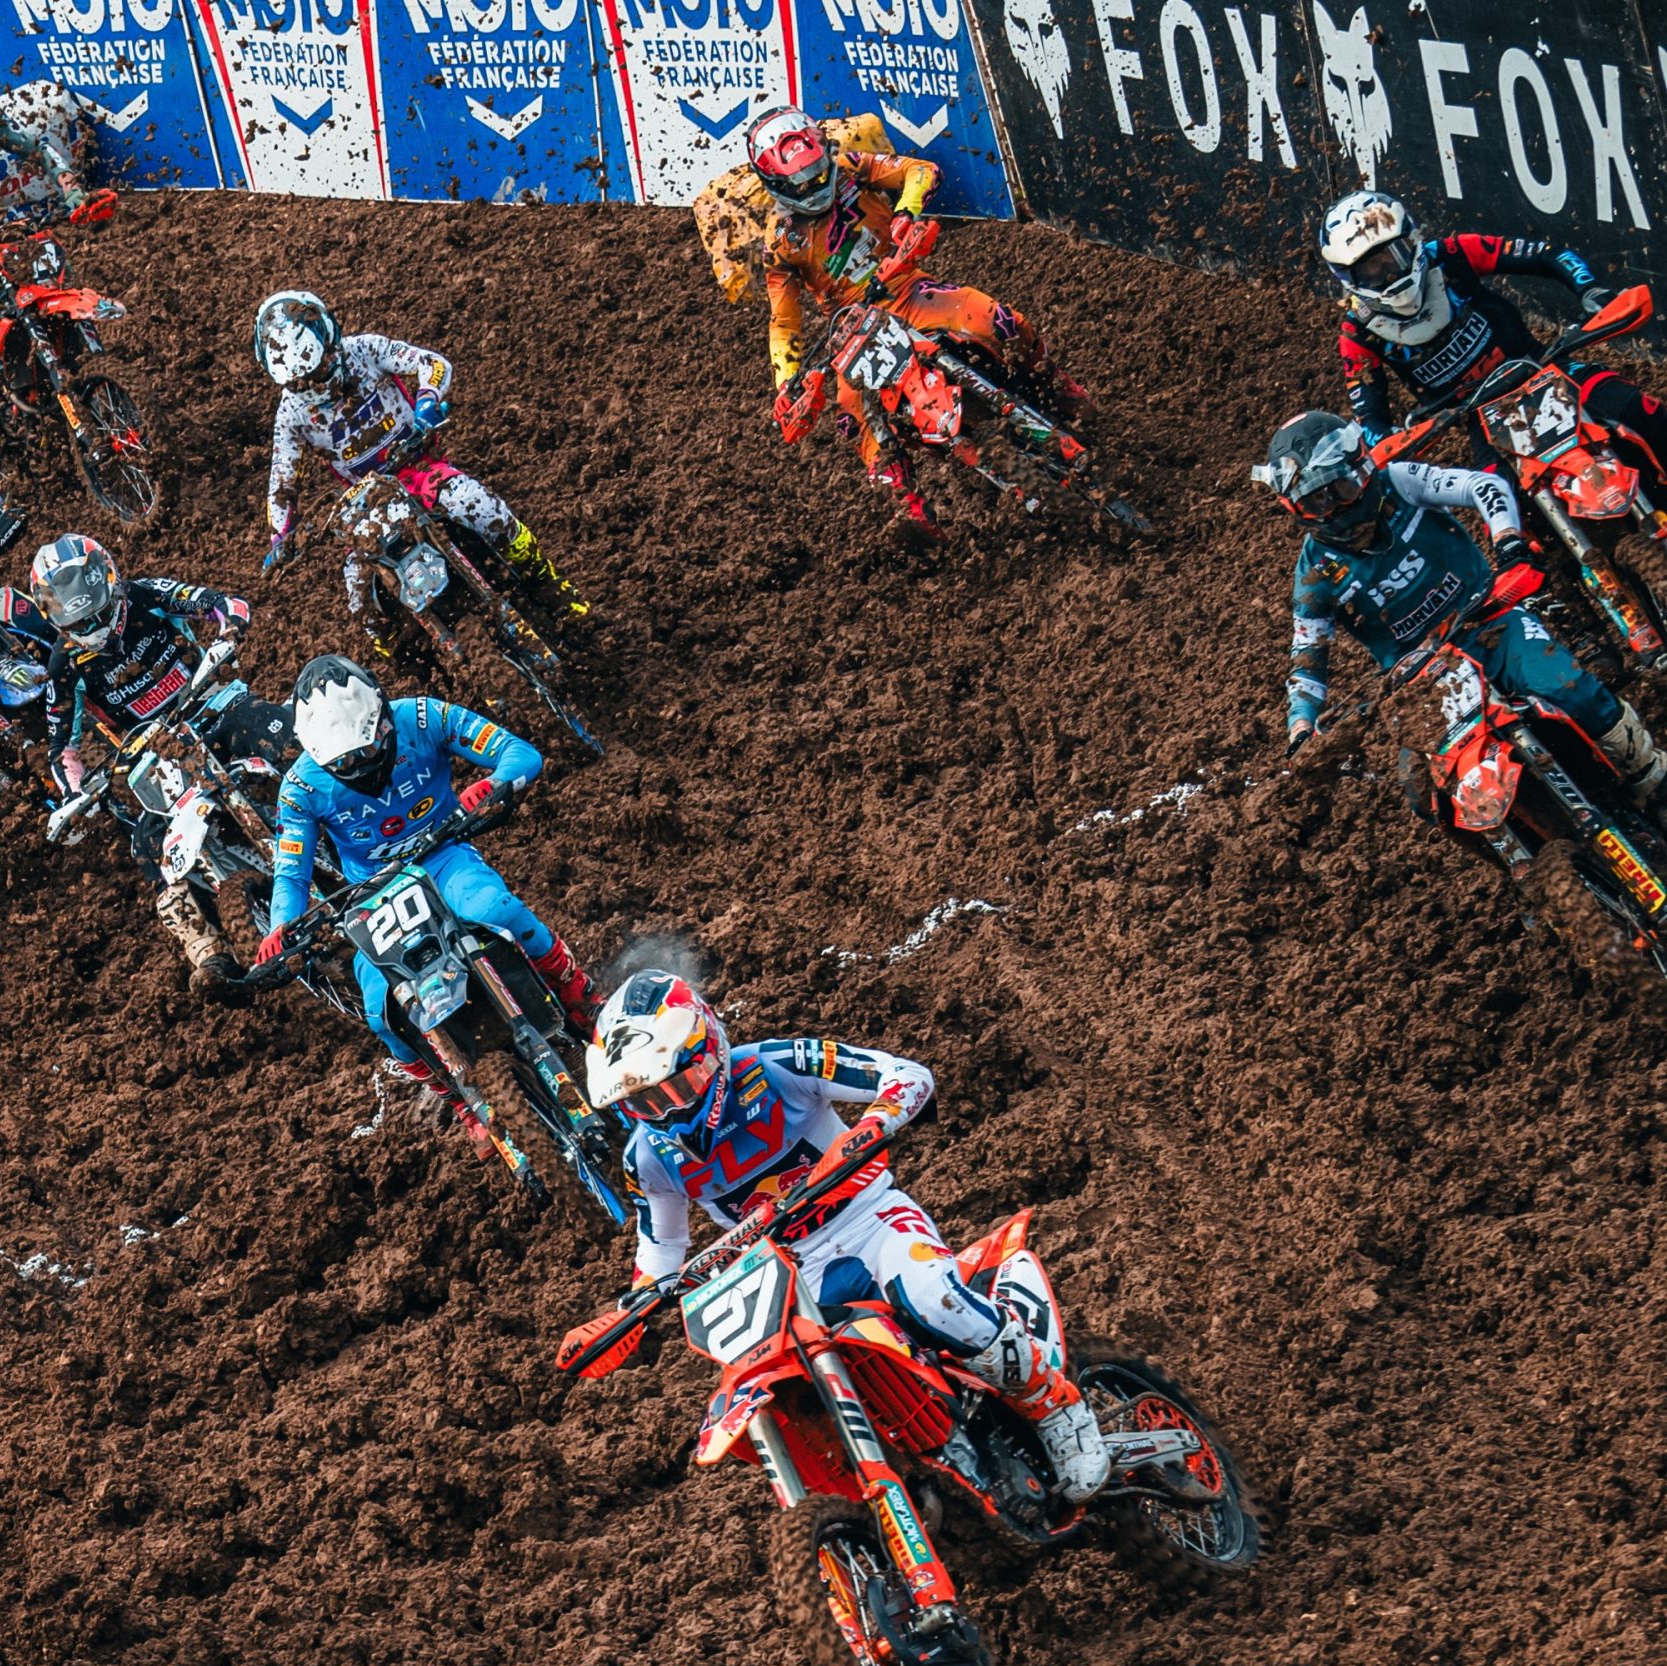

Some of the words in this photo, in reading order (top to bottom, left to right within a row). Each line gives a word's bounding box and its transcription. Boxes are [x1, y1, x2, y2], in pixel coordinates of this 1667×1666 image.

[37, 36, 165, 65] FÉDÉRATION
[241, 36, 348, 66] FÉDÉRATION
[428, 35, 566, 66] FÉDÉRATION
[644, 34, 767, 64] FÉDÉRATION
[844, 36, 959, 71] FÉDÉRATION
[51, 63, 163, 88] FRANÇAISE
[250, 66, 346, 89] FRANÇAISE
[440, 66, 561, 93] FRANÇAISE
[658, 63, 765, 90] FRANÇAISE
[856, 68, 959, 98] FRANÇAISE
[1094, 0, 1296, 168] FOX
[1418, 39, 1650, 230] FOX
[1415, 313, 1487, 383] HORVÁTH
[336, 767, 431, 824] RAVEN
[1600, 834, 1663, 911] PIRELLI
[367, 884, 431, 956] 20
[598, 1074, 651, 1104] AIROH
[717, 1121, 739, 1139] DEKRA
[842, 1130, 873, 1158] KTM
[680, 1100, 785, 1200] FLY
[702, 1259, 778, 1365] 27
[562, 1339, 582, 1363] KTM
[747, 1344, 772, 1365] KTM
[888, 1485, 921, 1544] MOTOREX
